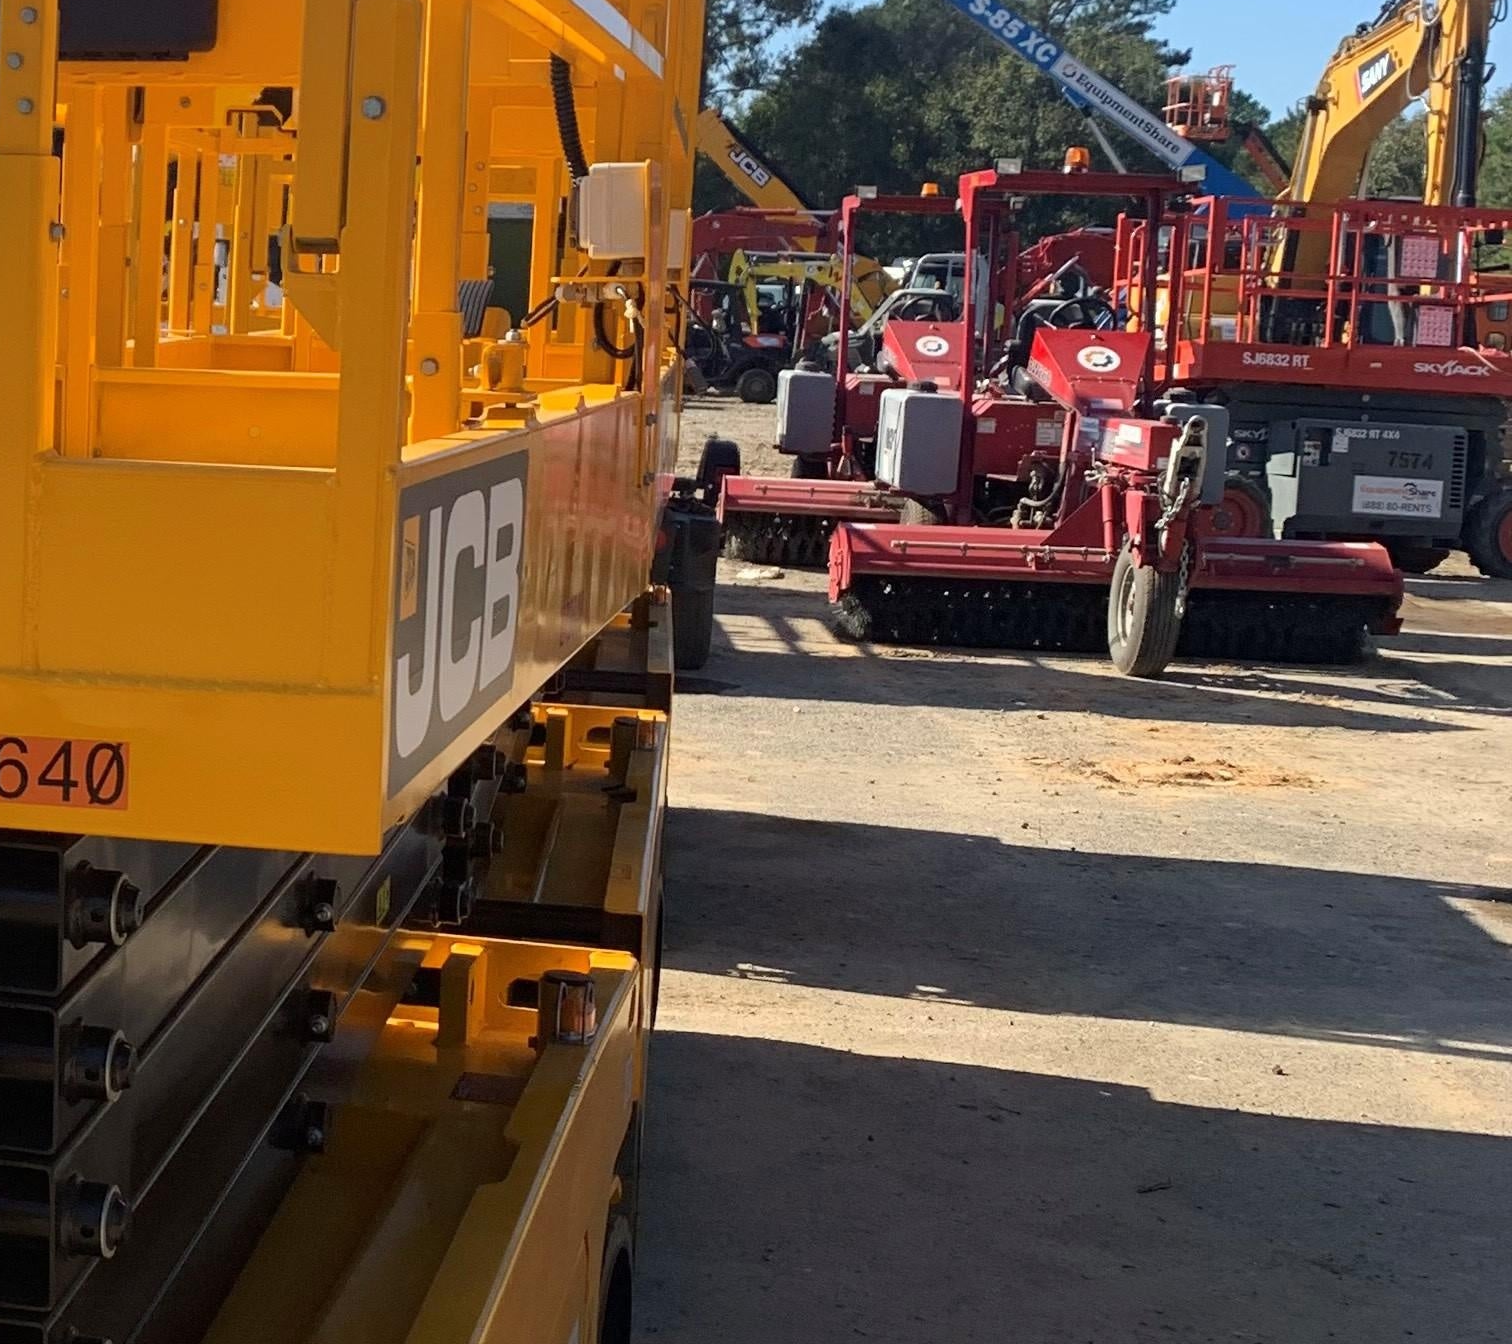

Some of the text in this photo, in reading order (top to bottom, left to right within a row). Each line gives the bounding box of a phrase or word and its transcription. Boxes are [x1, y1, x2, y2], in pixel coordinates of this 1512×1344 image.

[1018, 31, 1057, 63] XC
[1360, 52, 1390, 94] SANY
[1076, 72, 1180, 156] EquipmentShare
[729, 150, 770, 187] JCB
[1242, 352, 1310, 368] SJ6832 RT
[1413, 359, 1490, 377] SKYJACK
[395, 477, 524, 758] JCB
